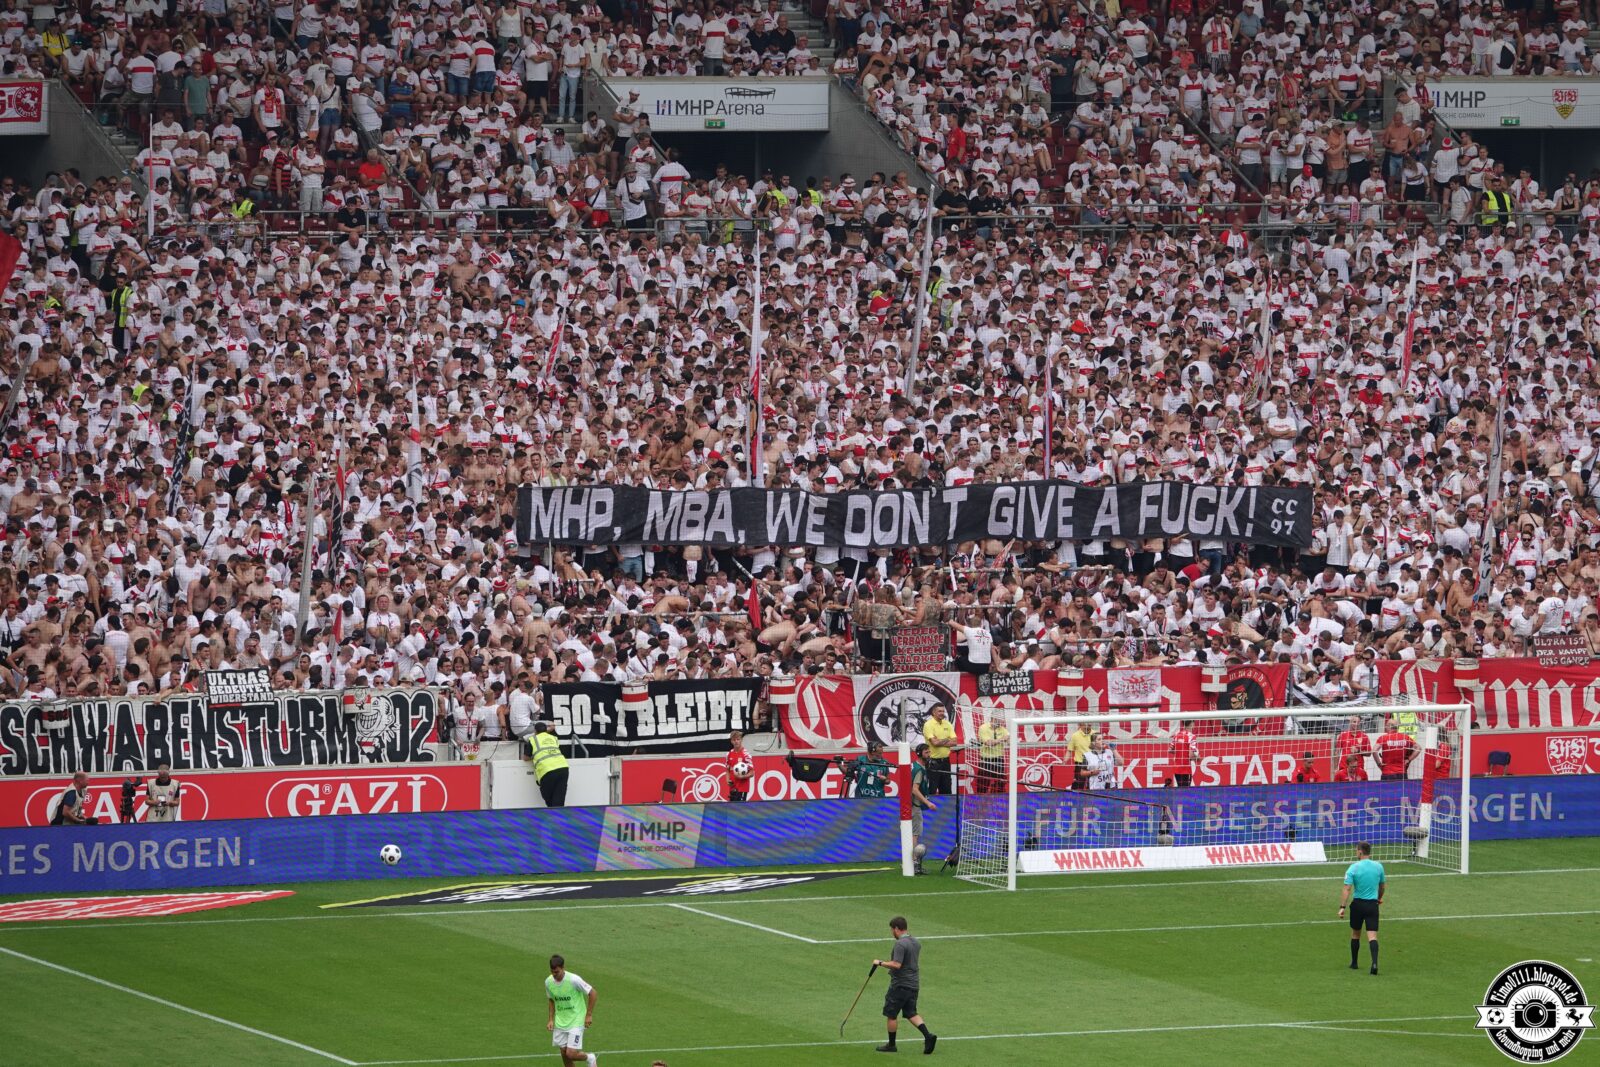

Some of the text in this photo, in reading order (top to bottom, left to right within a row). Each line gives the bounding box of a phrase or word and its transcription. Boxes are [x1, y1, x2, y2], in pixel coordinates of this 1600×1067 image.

[1444, 90, 1486, 108] MHP
[675, 99, 765, 116] MHP Arena
[1271, 497, 1299, 515] CC
[530, 482, 1257, 547] MHP, MBA, WE DON'T GIVE A FUCK!
[1270, 518, 1296, 535] 97
[897, 626, 939, 636] JEDER
[891, 634, 945, 647] VERBANNTE
[1534, 637, 1585, 647] ULTRA IST
[897, 645, 940, 655] KEHRT
[1536, 647, 1587, 658] DER KAMPF
[1560, 656, 1590, 666] GANZE
[207, 670, 270, 686] ULTRAS
[1010, 670, 1029, 678] BIST
[209, 682, 271, 696] BEDEUTET
[880, 681, 935, 696] VIKING 1986
[992, 677, 1031, 687] IMMER
[993, 686, 1008, 694] BEI
[209, 692, 274, 704] WIDERSTAND
[636, 690, 752, 737] BLEIBT!
[155, 809, 166, 818] TV
[1033, 801, 1102, 838] FÜR
[1203, 797, 1381, 832] BESSERES
[639, 820, 686, 841] MHP
[72, 836, 255, 874] MORGEN.
[623, 845, 654, 853] PORSCHE
[655, 844, 686, 852] COMPANY
[1205, 843, 1296, 865] WINAMAX
[1053, 849, 1145, 870] WINAMAX
